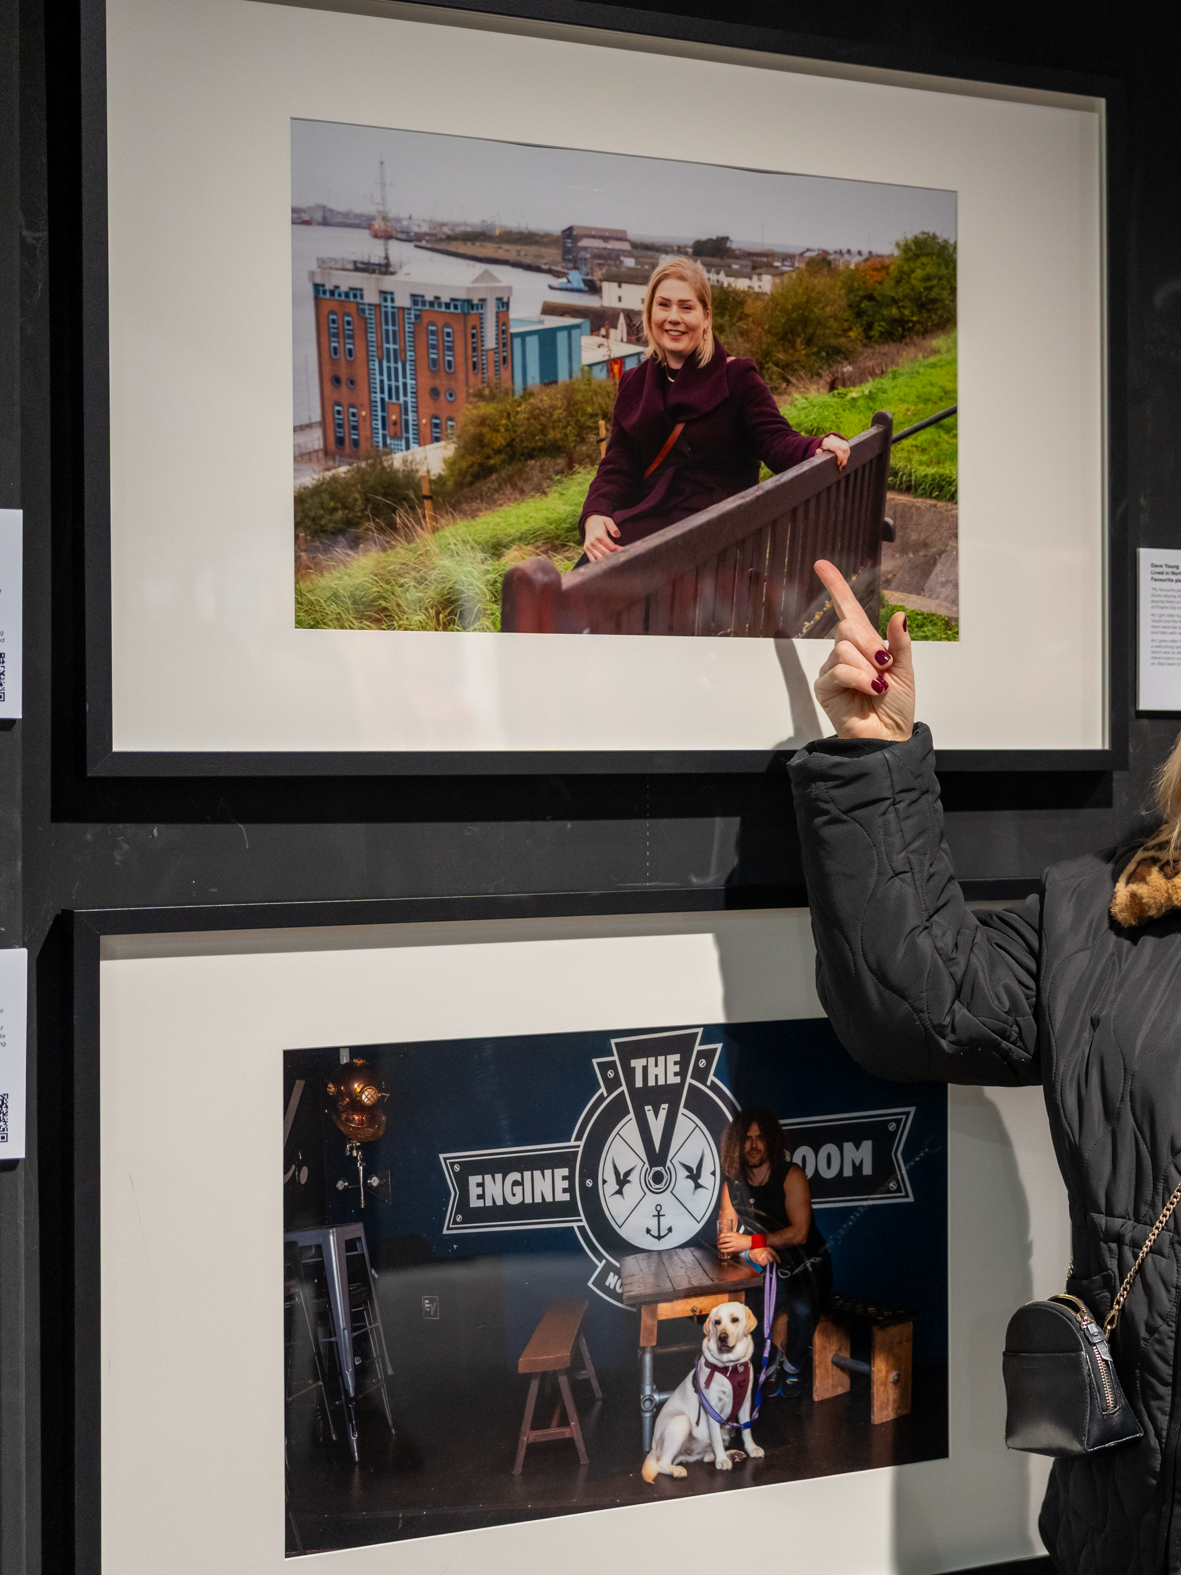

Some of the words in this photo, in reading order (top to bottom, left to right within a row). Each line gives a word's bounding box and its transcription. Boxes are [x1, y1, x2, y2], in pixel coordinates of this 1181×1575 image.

[630, 1053, 681, 1087] THE
[468, 1167, 570, 1208] ENGINE
[783, 1140, 873, 1180] OOM
